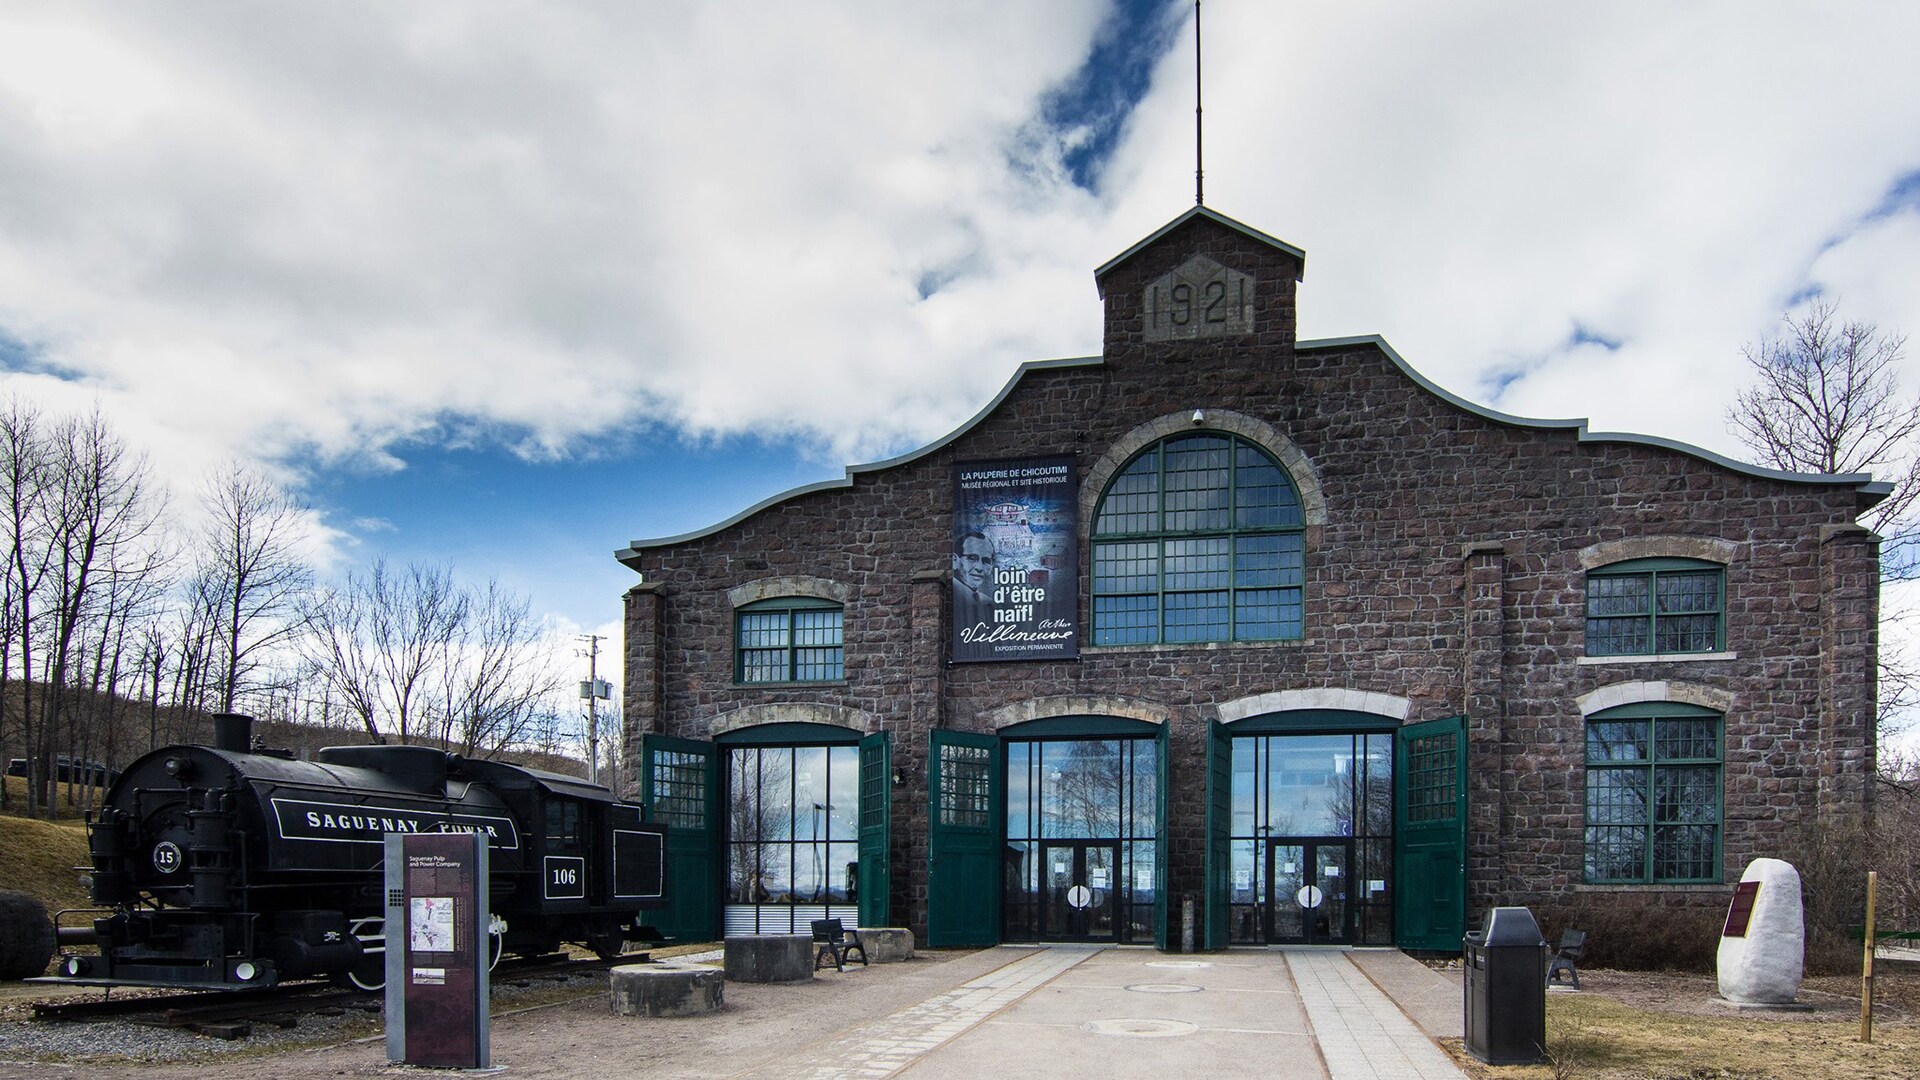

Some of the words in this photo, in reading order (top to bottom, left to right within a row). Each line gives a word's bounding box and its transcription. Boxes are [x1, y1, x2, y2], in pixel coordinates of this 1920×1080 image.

[1152, 278, 1245, 329] 1921
[961, 472, 972, 480] LA
[972, 470, 1008, 480] PULPERIE
[1009, 469, 1020, 478] DE
[1021, 466, 1068, 477] CHICOUTIMI
[961, 481, 982, 489] MUSÉE
[982, 479, 1011, 488] RÉGIONAL
[1011, 479, 1019, 487] ET
[1019, 478, 1032, 486] SITE
[1032, 475, 1068, 485] HISTORIQUE
[994, 567, 1026, 584] loin
[994, 586, 1045, 604] d'être
[994, 604, 1033, 623] naïf!
[1027, 643, 1064, 651] PERMANENTE
[305, 811, 418, 833] SAGUENAY
[160, 851, 174, 863] 15
[553, 868, 576, 885] 106
